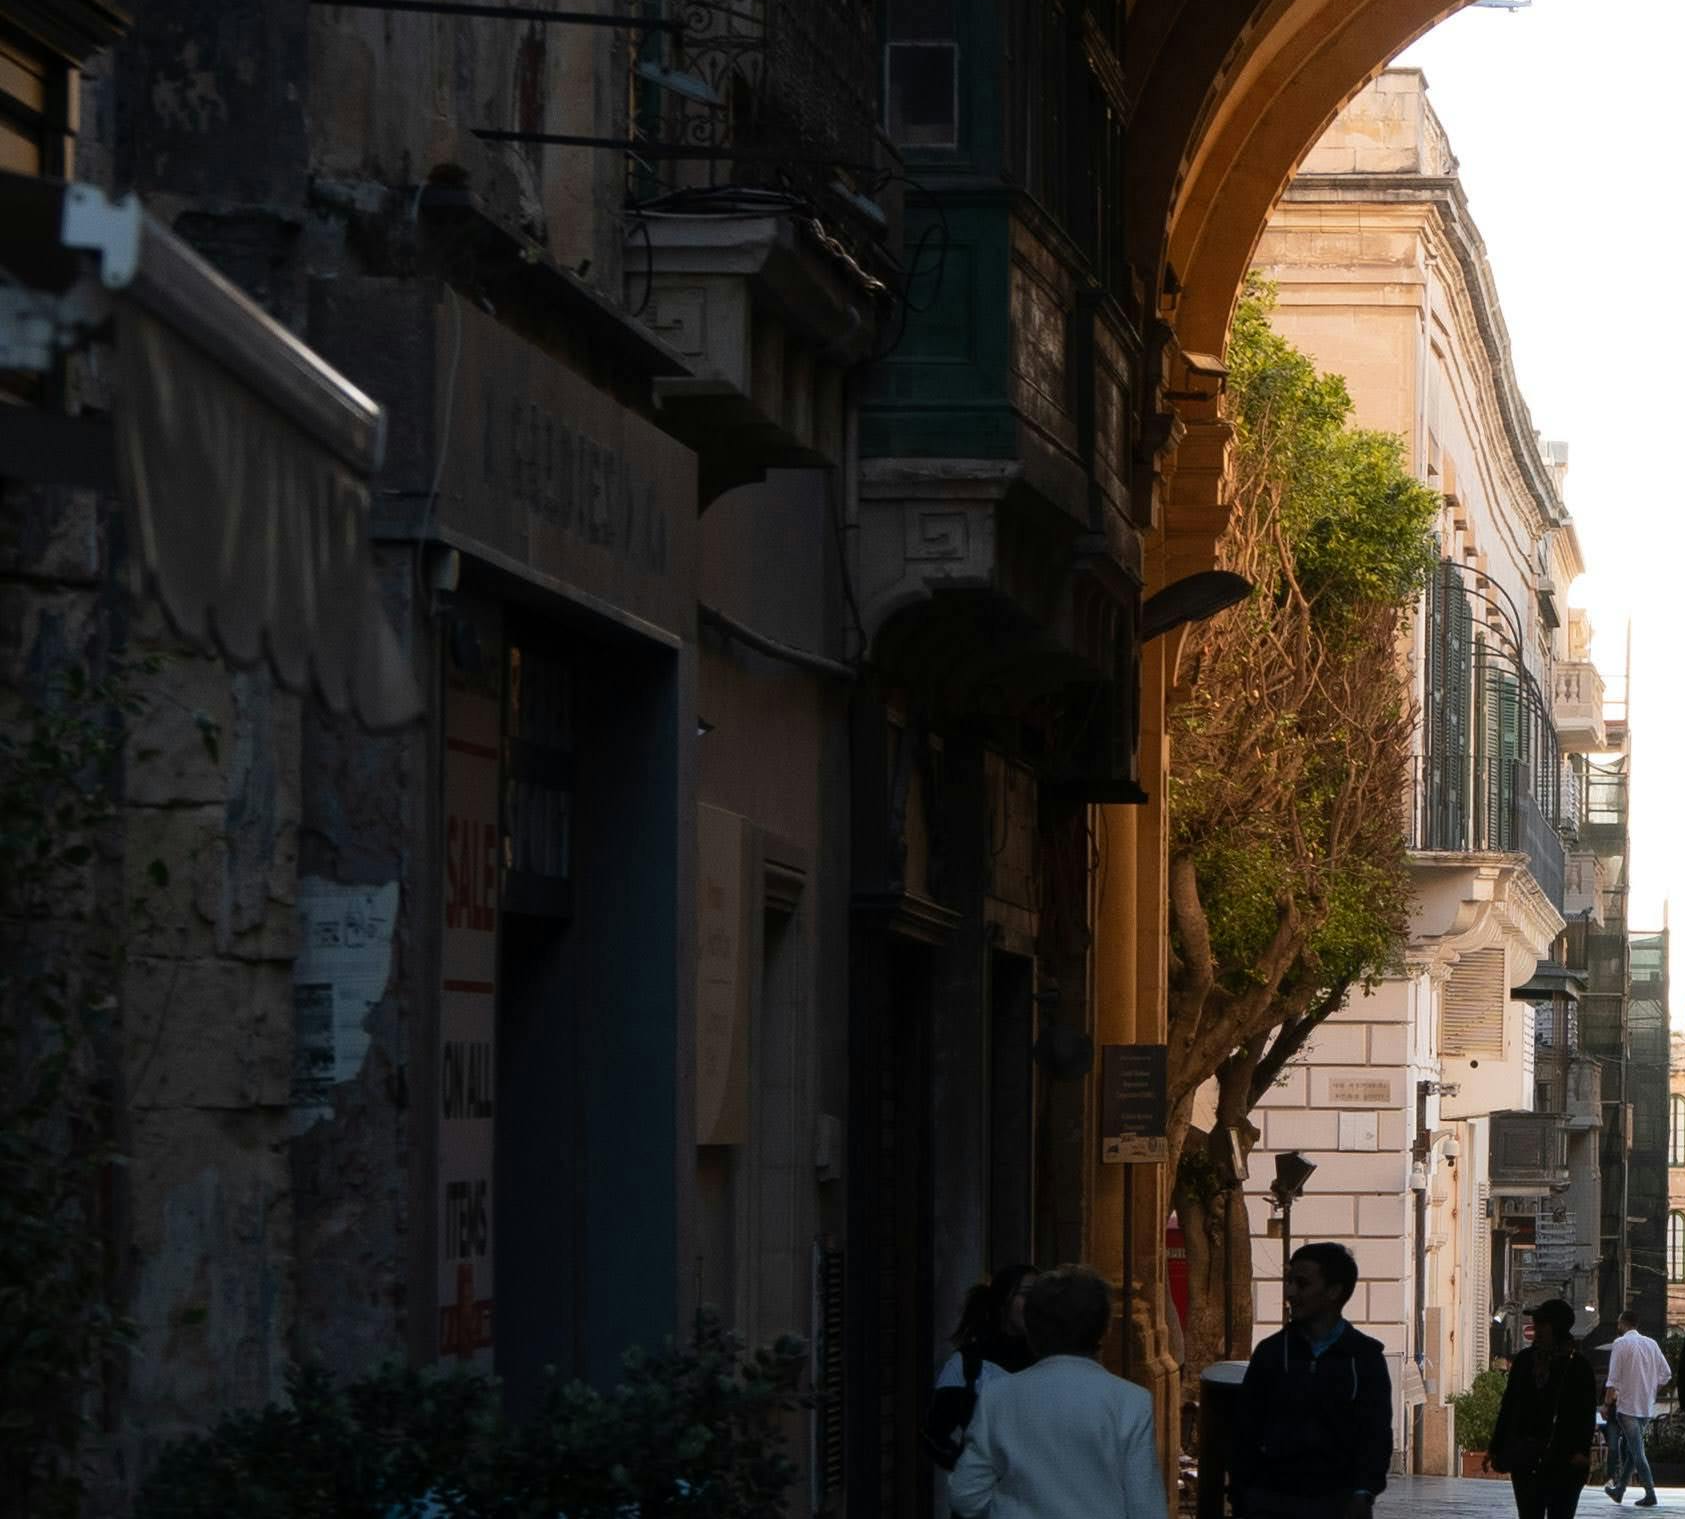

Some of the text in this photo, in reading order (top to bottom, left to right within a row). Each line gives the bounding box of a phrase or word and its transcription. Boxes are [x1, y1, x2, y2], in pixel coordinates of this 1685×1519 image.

[447, 816, 497, 931] SALE
[443, 1041, 495, 1120] ON ALL
[446, 1181, 488, 1259] ITEMS
